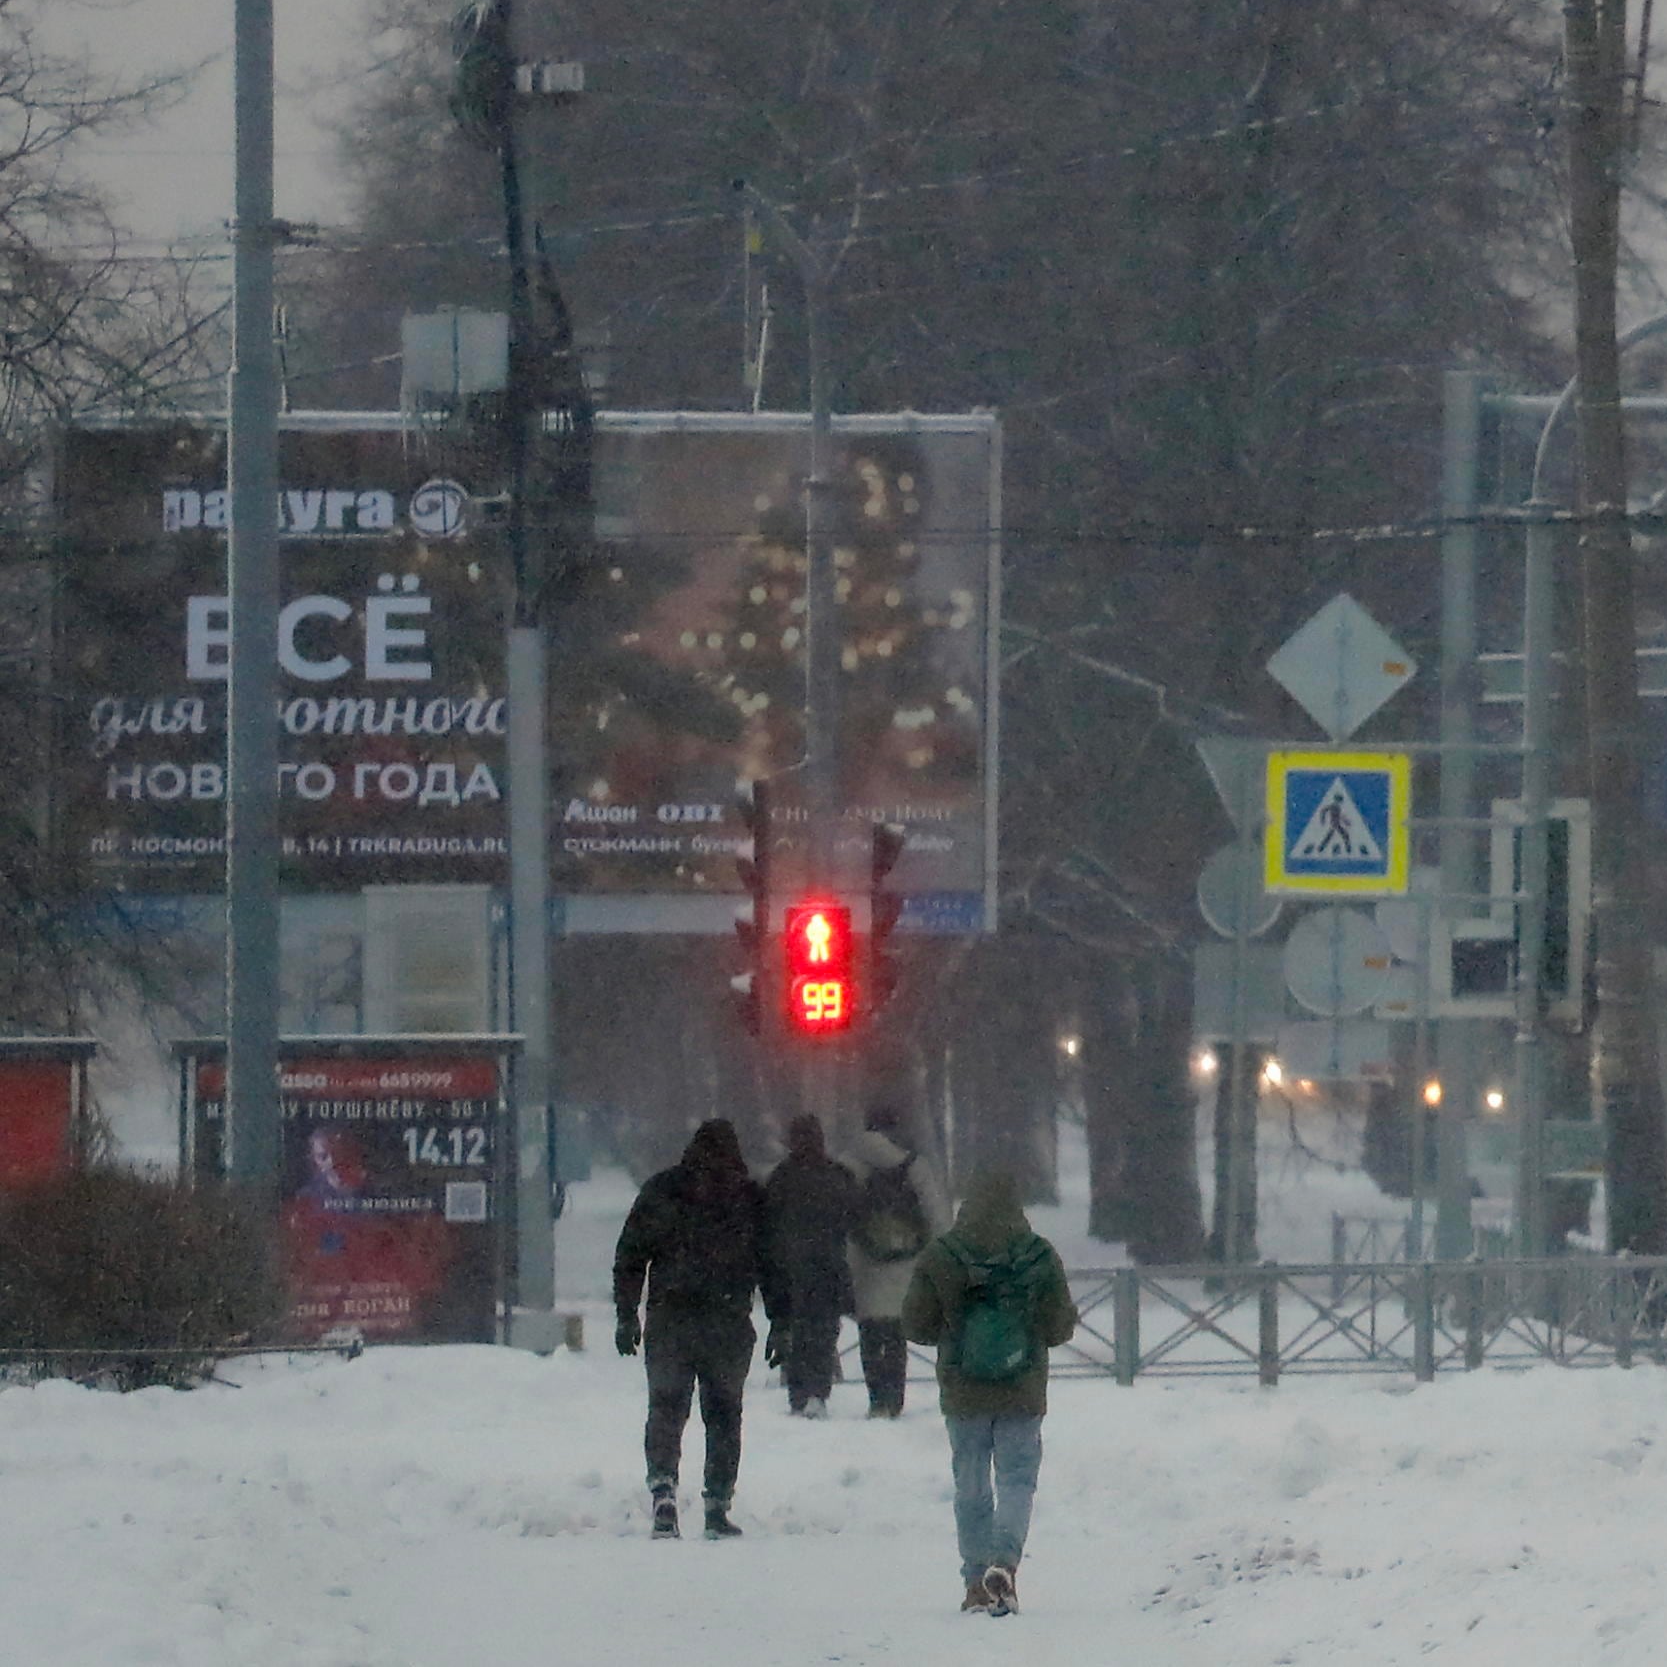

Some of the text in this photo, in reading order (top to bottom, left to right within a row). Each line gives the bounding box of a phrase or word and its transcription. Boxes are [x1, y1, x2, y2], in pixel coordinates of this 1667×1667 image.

[163, 489, 395, 532] рауга
[90, 693, 207, 757] для
[106, 763, 500, 807] НОВГО ГОДА
[802, 983, 843, 1020] 99
[403, 1127, 486, 1165] 14.12
